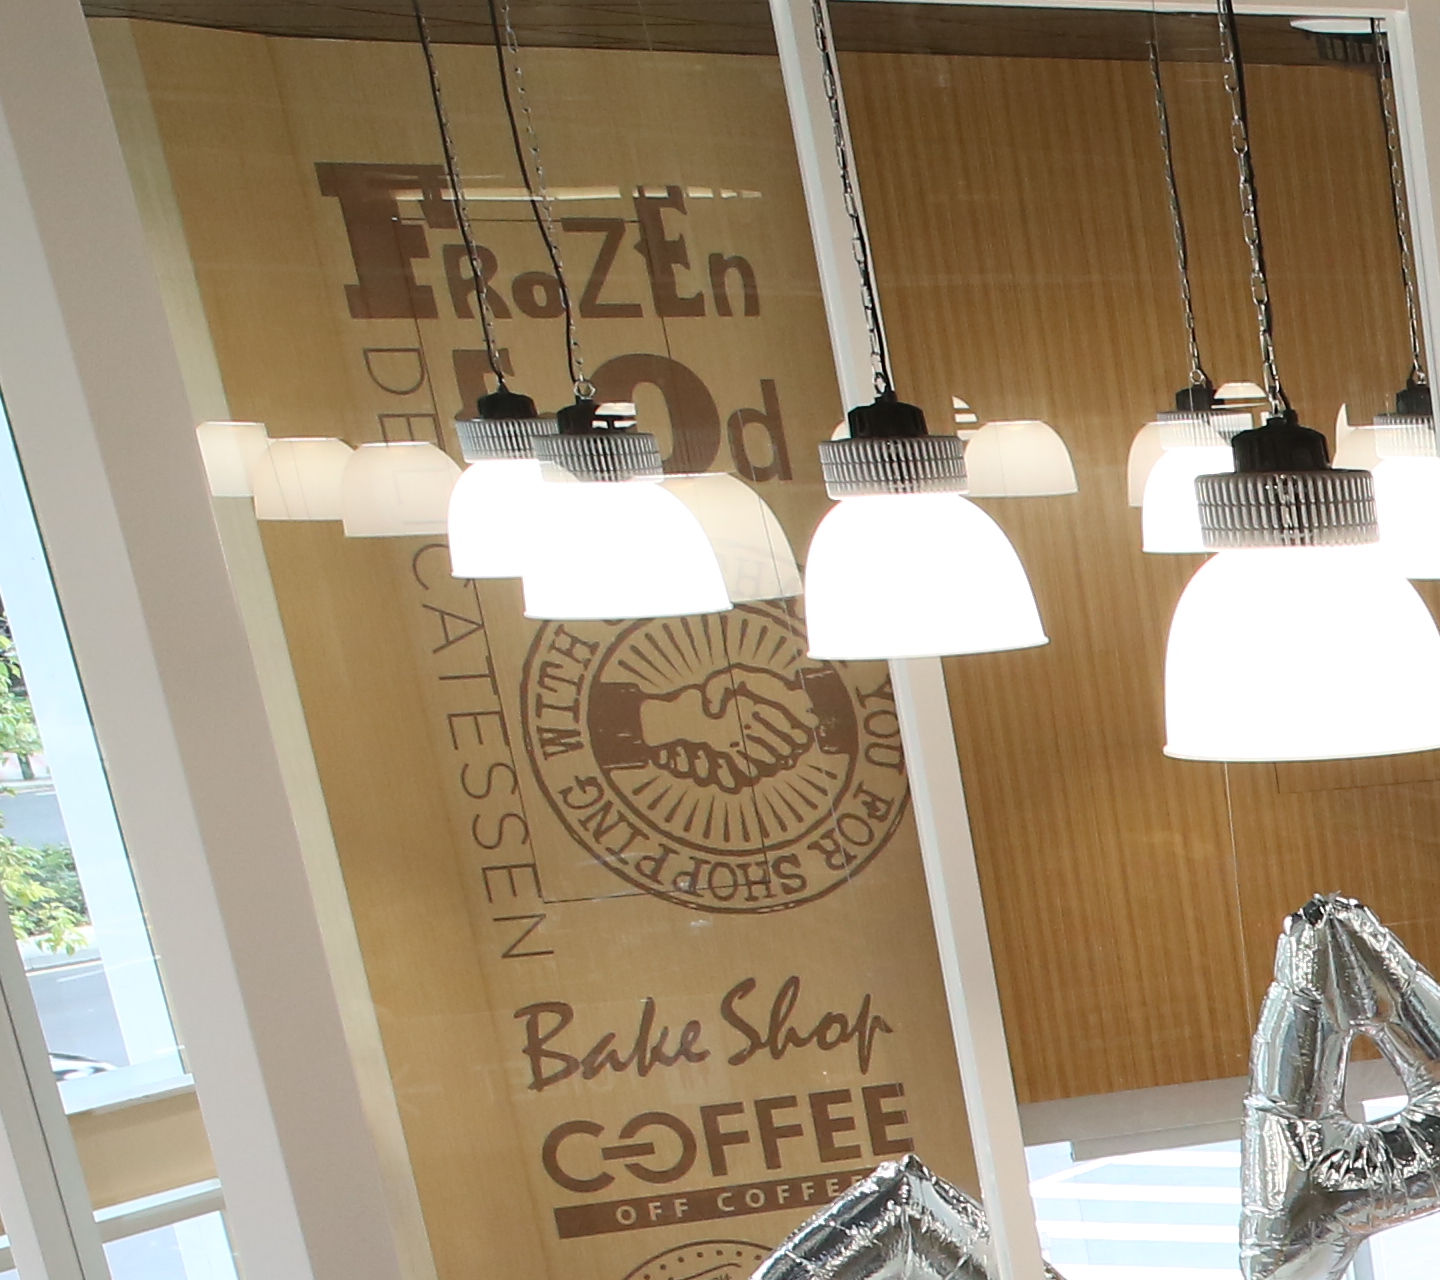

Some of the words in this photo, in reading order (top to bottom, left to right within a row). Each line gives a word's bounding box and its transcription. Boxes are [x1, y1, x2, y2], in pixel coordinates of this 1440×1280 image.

[535, 624, 600, 762] WITH
[558, 774, 809, 903] SHOPPING
[807, 780, 897, 872] FOR
[513, 1001, 711, 1092] Bake
[720, 975, 893, 1075] Shop
[542, 1082, 914, 1194] COFFEE
[615, 1199, 690, 1226] OFF
